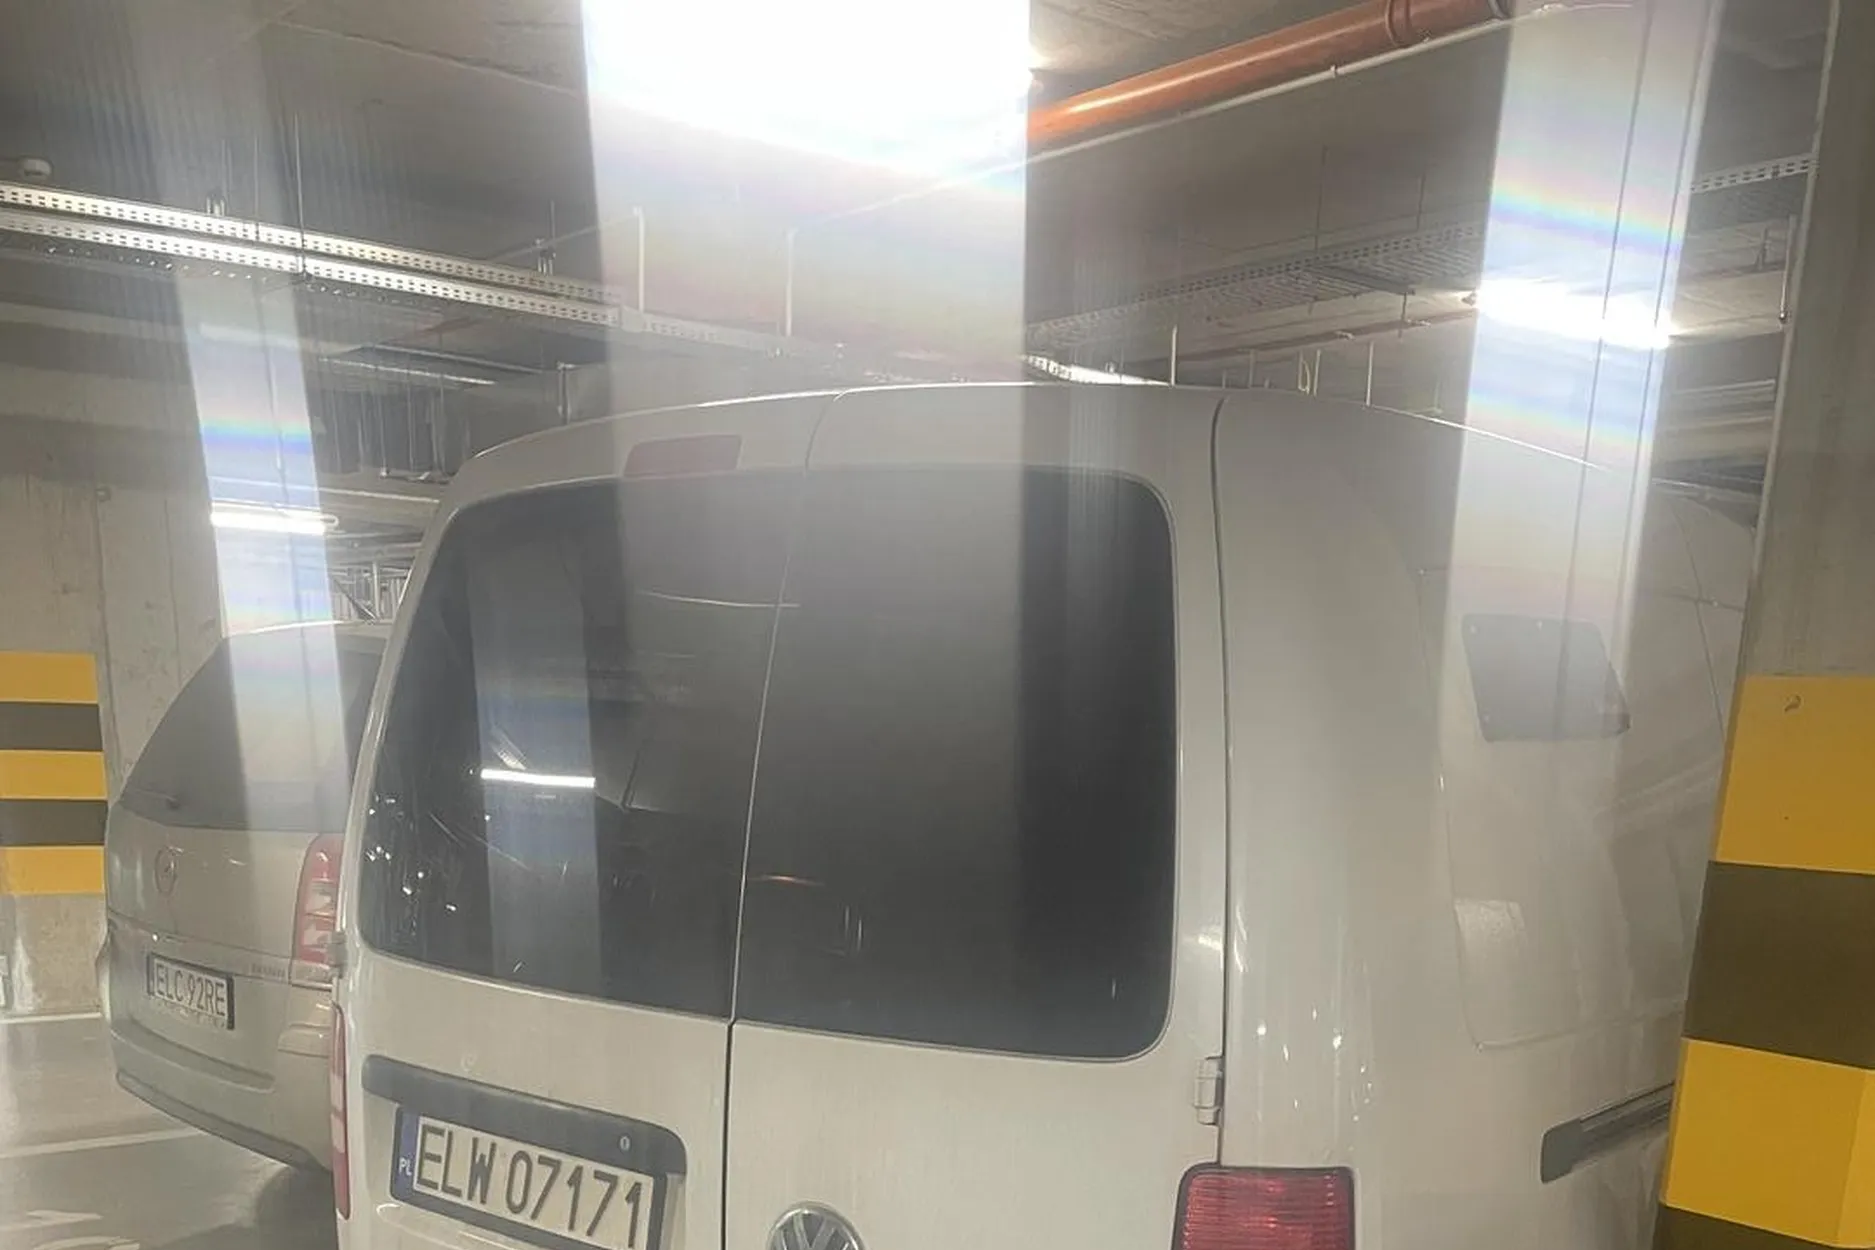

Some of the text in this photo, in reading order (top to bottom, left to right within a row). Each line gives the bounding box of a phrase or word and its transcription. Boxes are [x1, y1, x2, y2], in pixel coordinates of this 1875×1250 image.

[156, 963, 183, 1002] ELC
[398, 1156, 413, 1177] PL
[416, 1124, 643, 1250] ELW 07171
